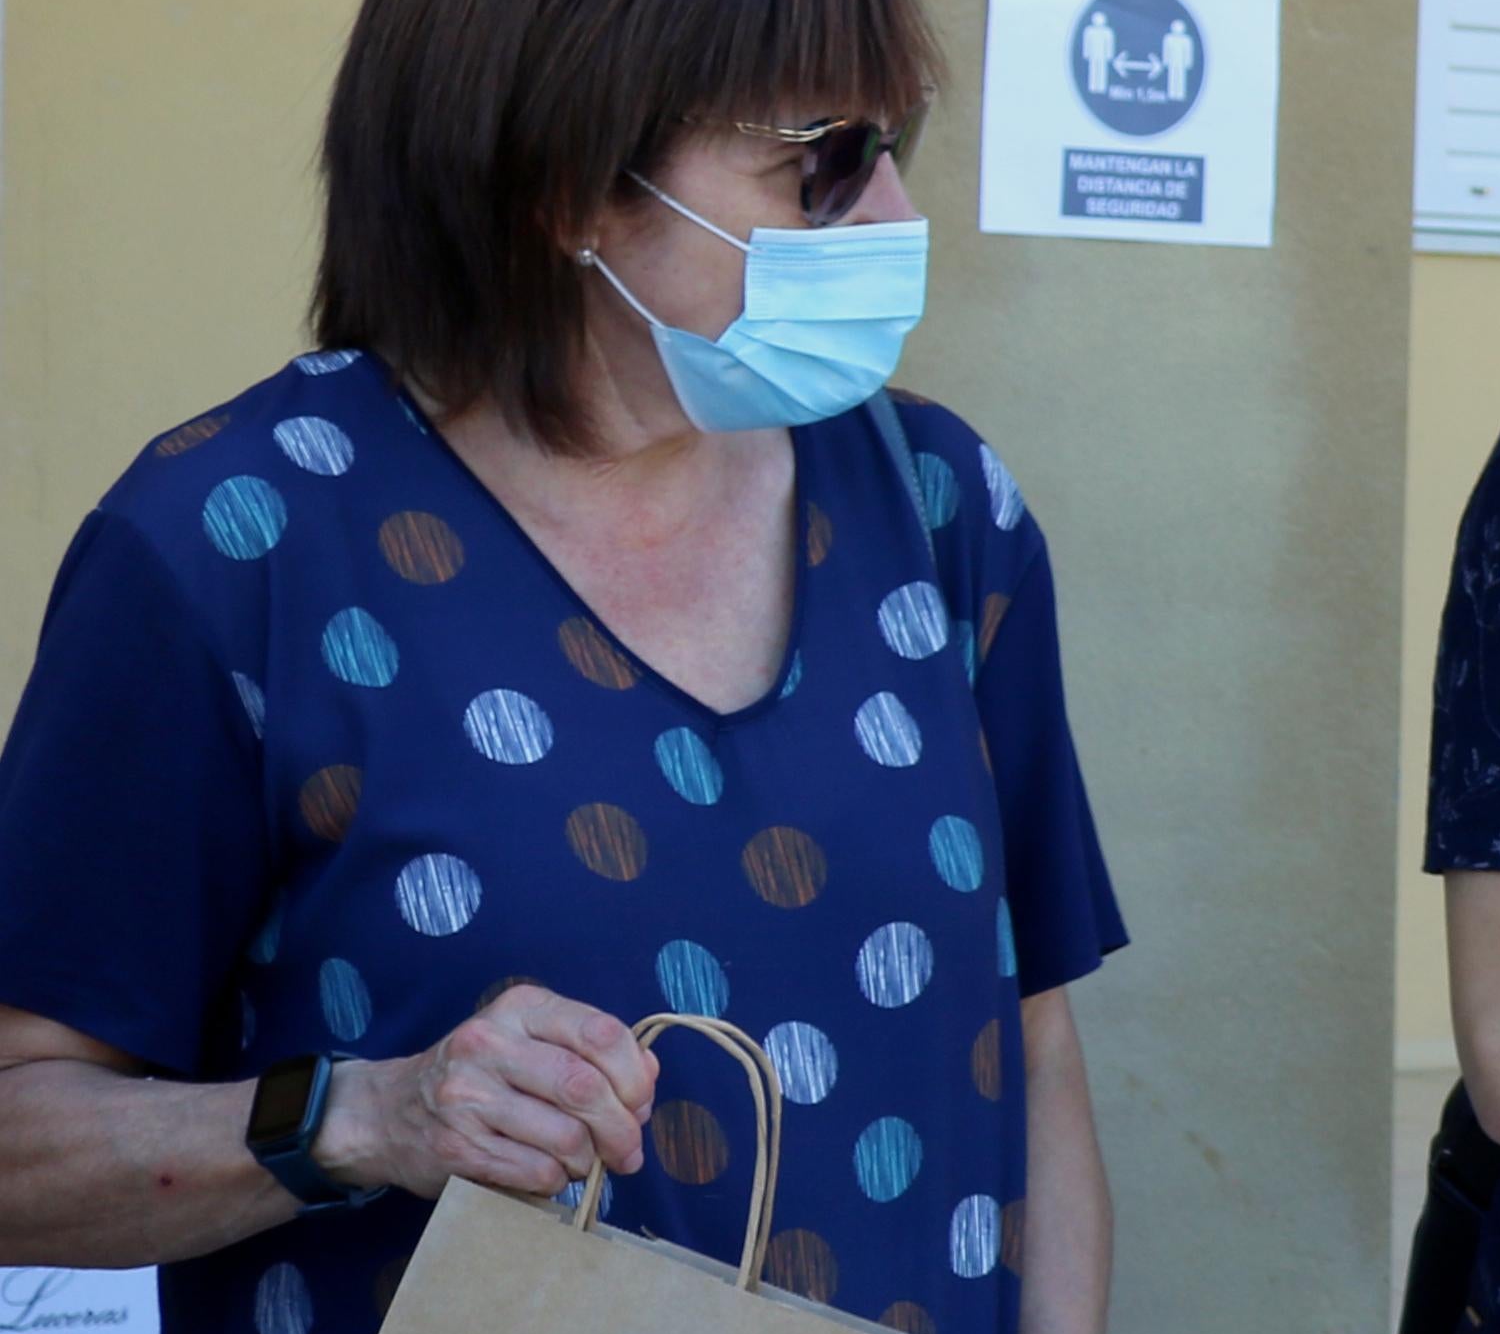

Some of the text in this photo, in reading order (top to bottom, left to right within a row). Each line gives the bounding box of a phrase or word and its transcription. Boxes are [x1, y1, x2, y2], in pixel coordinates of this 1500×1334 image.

[1069, 152, 1197, 178] MANTENGAN LA
[1076, 174, 1188, 200] DISTANCIA DE
[1085, 196, 1181, 219] SEGURIDAD
